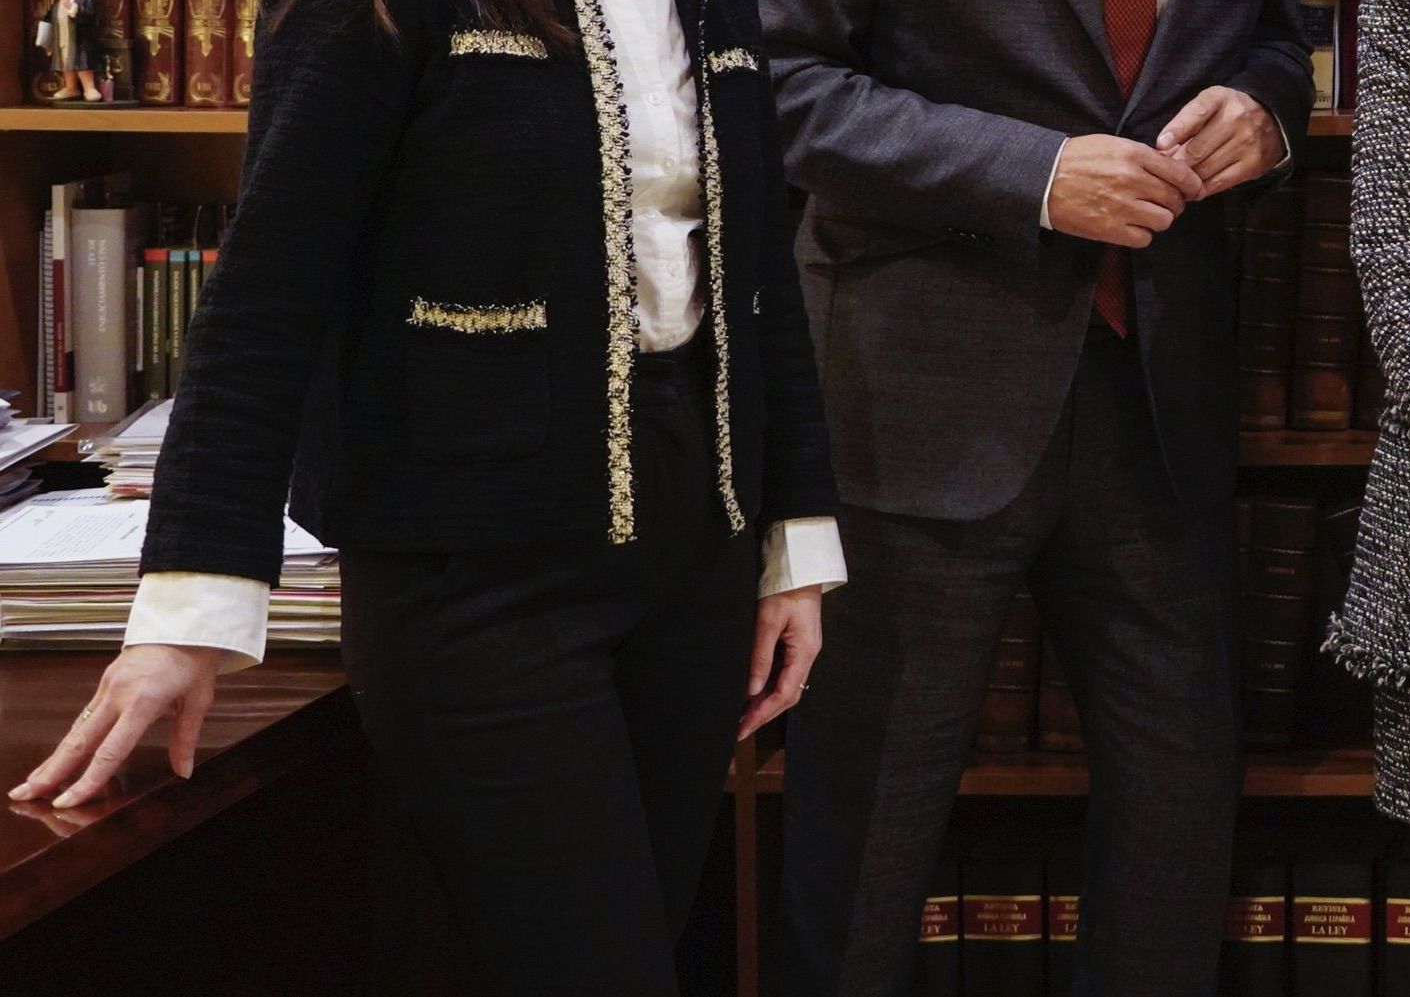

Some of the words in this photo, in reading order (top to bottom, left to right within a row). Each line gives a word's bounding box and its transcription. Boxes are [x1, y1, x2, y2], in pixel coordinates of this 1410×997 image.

[1312, 906, 1348, 914] REVISTA
[984, 924, 998, 933] LA
[1000, 924, 1019, 933] LEY
[1312, 926, 1326, 935] LA
[1328, 926, 1348, 935] LEY
